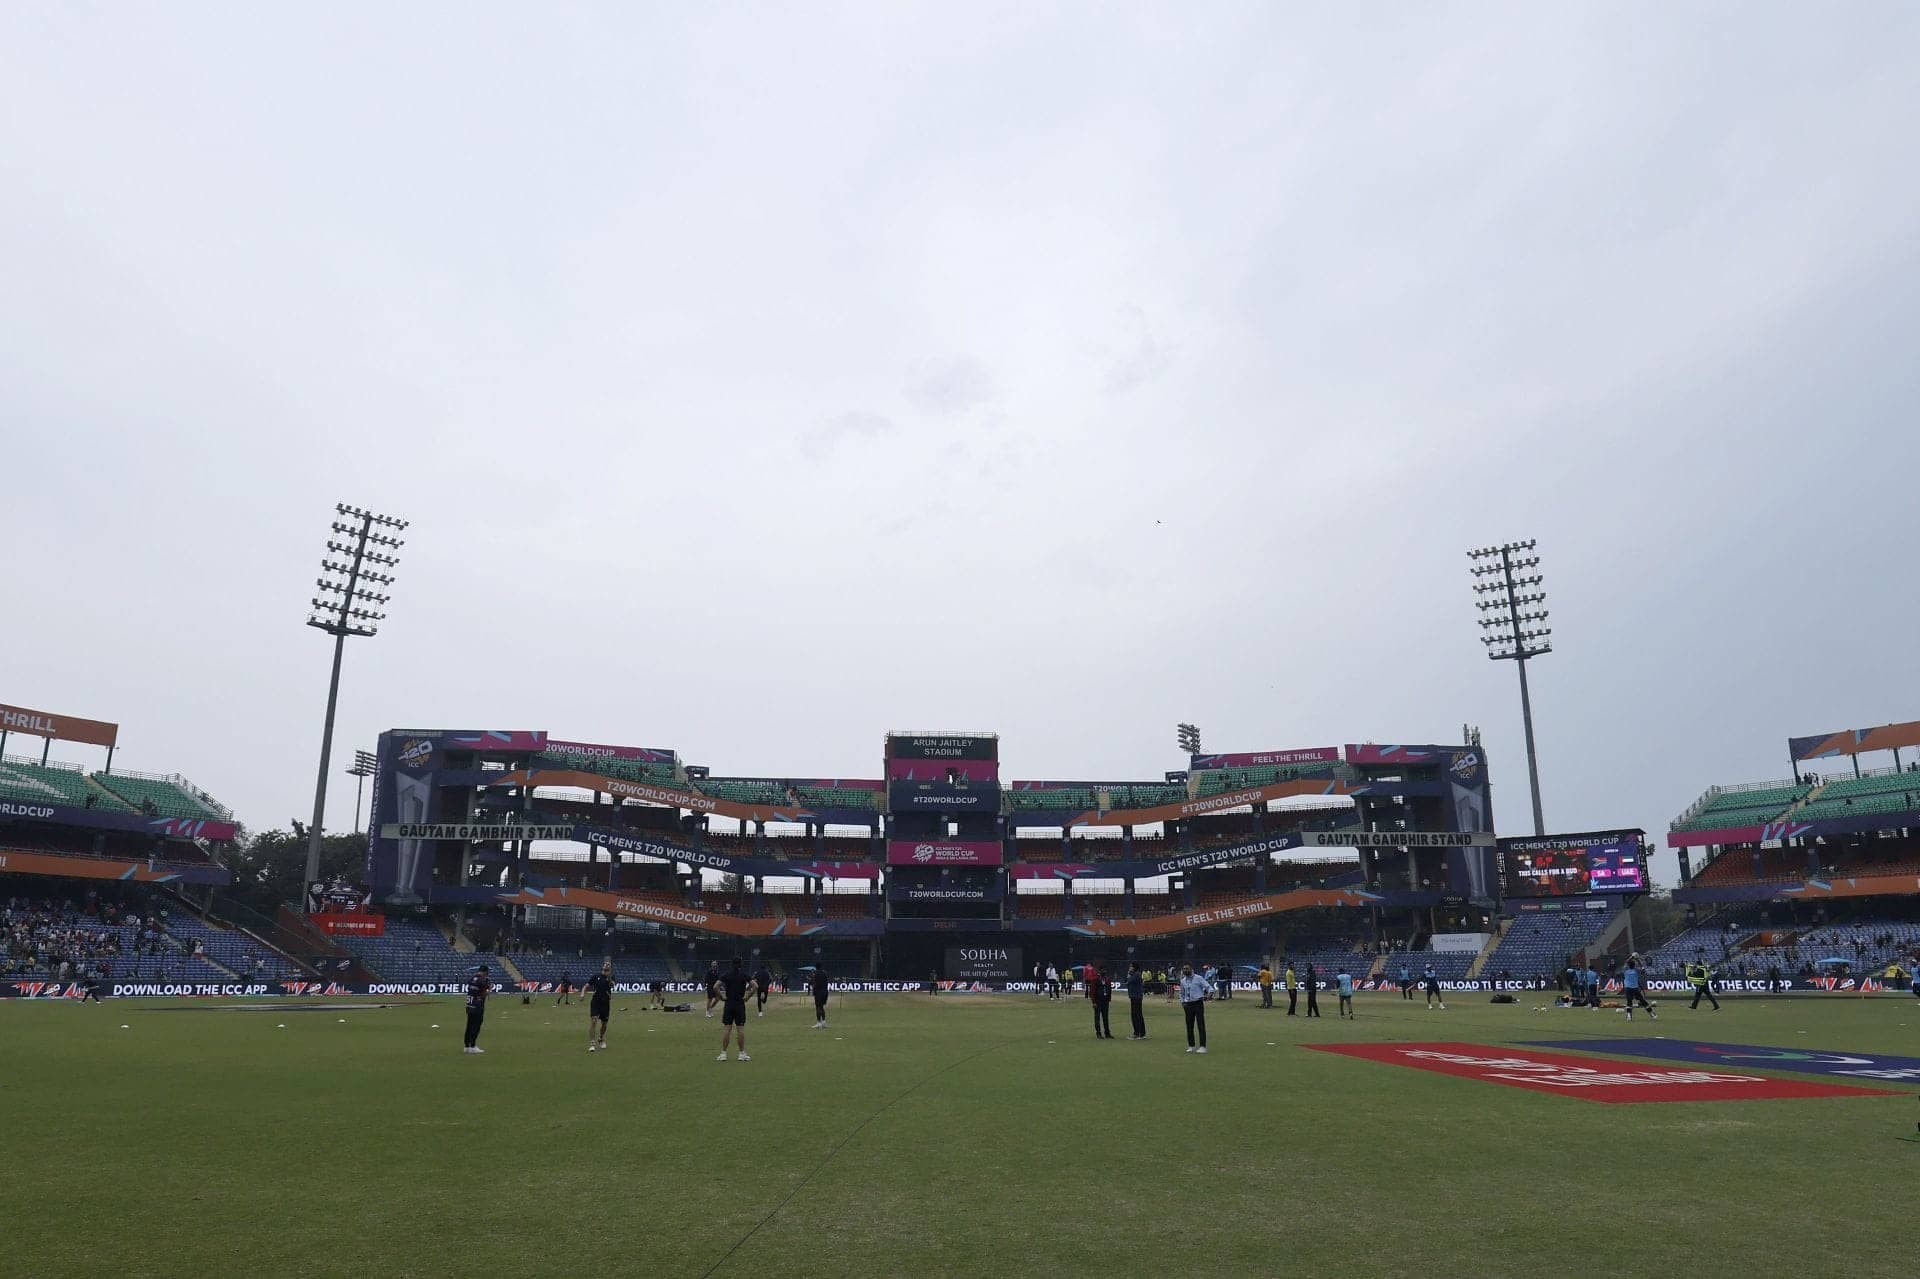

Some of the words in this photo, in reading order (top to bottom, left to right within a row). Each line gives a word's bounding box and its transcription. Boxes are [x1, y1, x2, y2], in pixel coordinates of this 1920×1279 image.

[913, 739, 937, 747] ARUN
[939, 739, 973, 747] JAITLEY
[924, 748, 962, 756] STADIUM
[1252, 755, 1274, 763] FEEL
[1275, 754, 1292, 762] THE
[1293, 752, 1323, 761] THRILL
[607, 781, 716, 810] T20WORLDCUP.COM
[1182, 791, 1263, 813] #T20WORLDCUP
[400, 825, 456, 840] GAUTAM
[459, 825, 524, 840] GAMBHIR
[528, 825, 573, 840] STAND
[1317, 834, 1370, 846] GAUTAM
[1372, 834, 1429, 846] GAMBHIR
[1431, 834, 1472, 846] STAND
[1511, 842, 1524, 850] ICC
[1526, 841, 1550, 850] MEN'S
[1552, 840, 1567, 849] T20
[1569, 839, 1600, 848] WORLD
[1602, 837, 1619, 845] CUP
[587, 831, 606, 843] ICC
[608, 835, 642, 851] MEN'S
[645, 842, 664, 855] T20
[666, 847, 706, 864] WORLD
[708, 856, 731, 868] CUP
[1157, 860, 1176, 872] ICC
[1177, 855, 1209, 869] MEN'S
[1210, 850, 1228, 862] T20
[1229, 843, 1267, 857] WORLD
[1269, 838, 1289, 850] CUP
[616, 900, 708, 925] #T20WORLDCUP
[1186, 911, 1212, 925] FEEL
[1213, 907, 1235, 920] THE
[1236, 901, 1273, 916] THRILL
[960, 949, 1008, 961] SOBHA
[113, 984, 192, 995] DOWNLOAD
[196, 984, 220, 995] THE
[221, 984, 242, 995] ICC
[244, 984, 268, 995] APP
[368, 984, 435, 993] DOWNLOAD
[439, 983, 460, 993] THE
[677, 983, 694, 992] ICC
[803, 983, 861, 991] DNLOAD
[862, 983, 881, 991] THE
[883, 983, 900, 991] ICC
[902, 983, 921, 991] APP
[1504, 980, 1523, 989] ICC
[1719, 980, 1743, 990] THE
[1746, 980, 1766, 990] ICC
